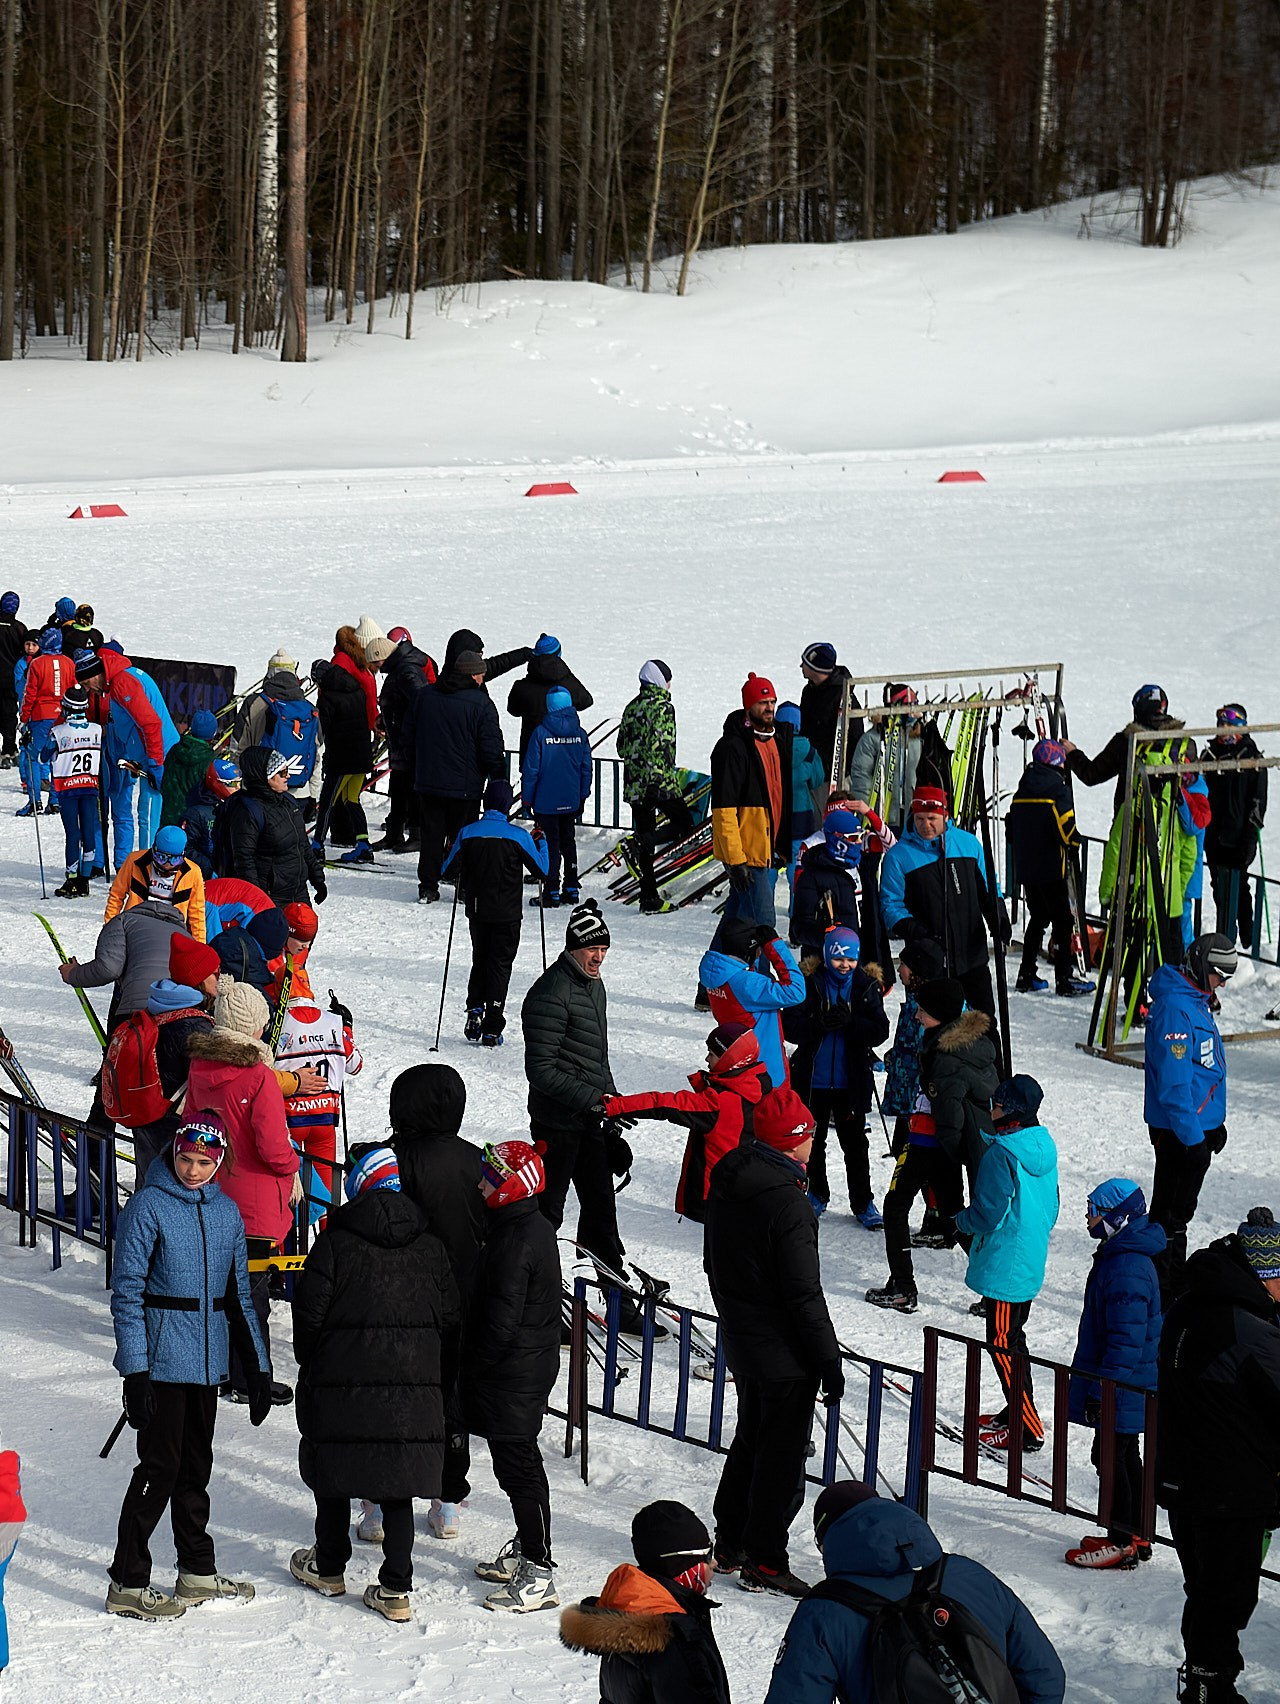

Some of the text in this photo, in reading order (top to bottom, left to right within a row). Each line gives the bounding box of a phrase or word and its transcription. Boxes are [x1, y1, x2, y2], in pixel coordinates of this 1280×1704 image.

[545, 736, 582, 745] RUSSIA
[71, 753, 93, 773] 26
[884, 736, 900, 794] FISCHER
[63, 777, 99, 787] УДМУРТИ
[308, 1034, 325, 1043] ПСБ
[289, 1097, 341, 1112] УДМУРТИ
[985, 1431, 1008, 1446] alp
